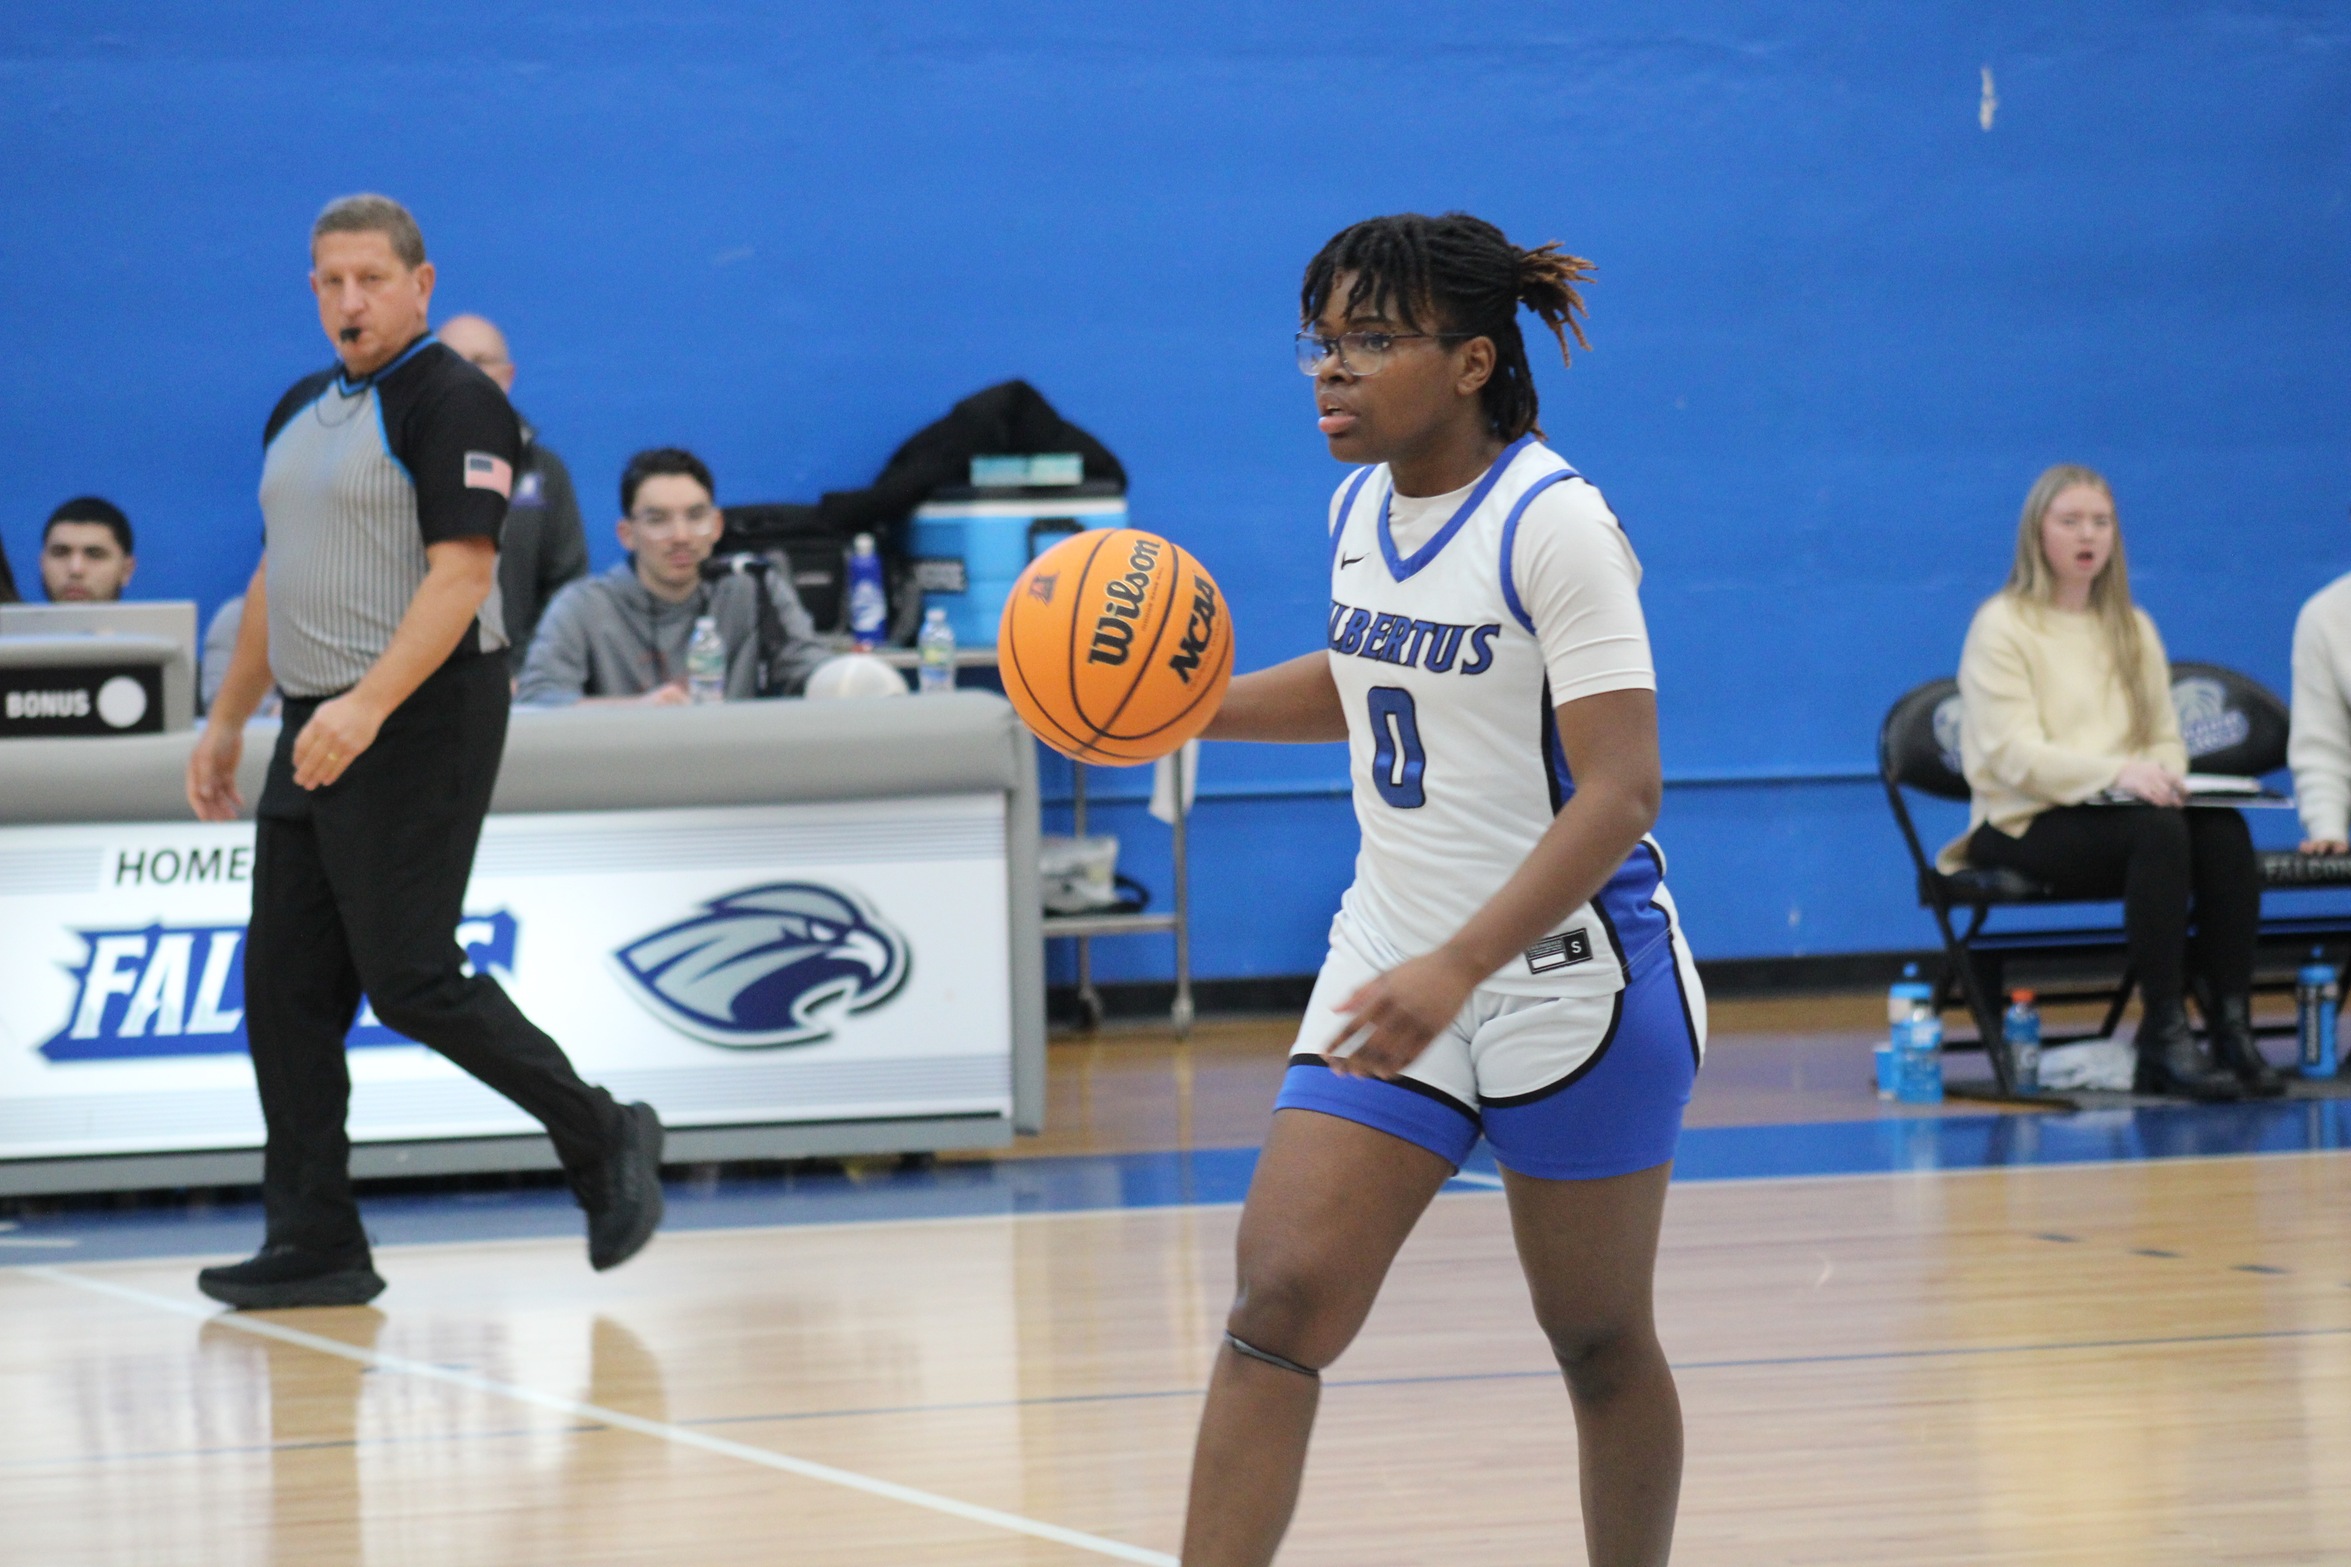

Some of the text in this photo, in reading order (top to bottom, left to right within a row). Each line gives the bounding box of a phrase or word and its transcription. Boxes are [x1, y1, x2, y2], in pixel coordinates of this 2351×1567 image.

[1088, 539, 1161, 667] Wilson
[1169, 574, 1215, 684] NCAA
[1329, 600, 1500, 675] LBERTUS
[5, 688, 91, 719] BONUS
[1367, 686, 1426, 809] 0
[114, 846, 252, 886] HOME
[1570, 941, 1582, 954] S
